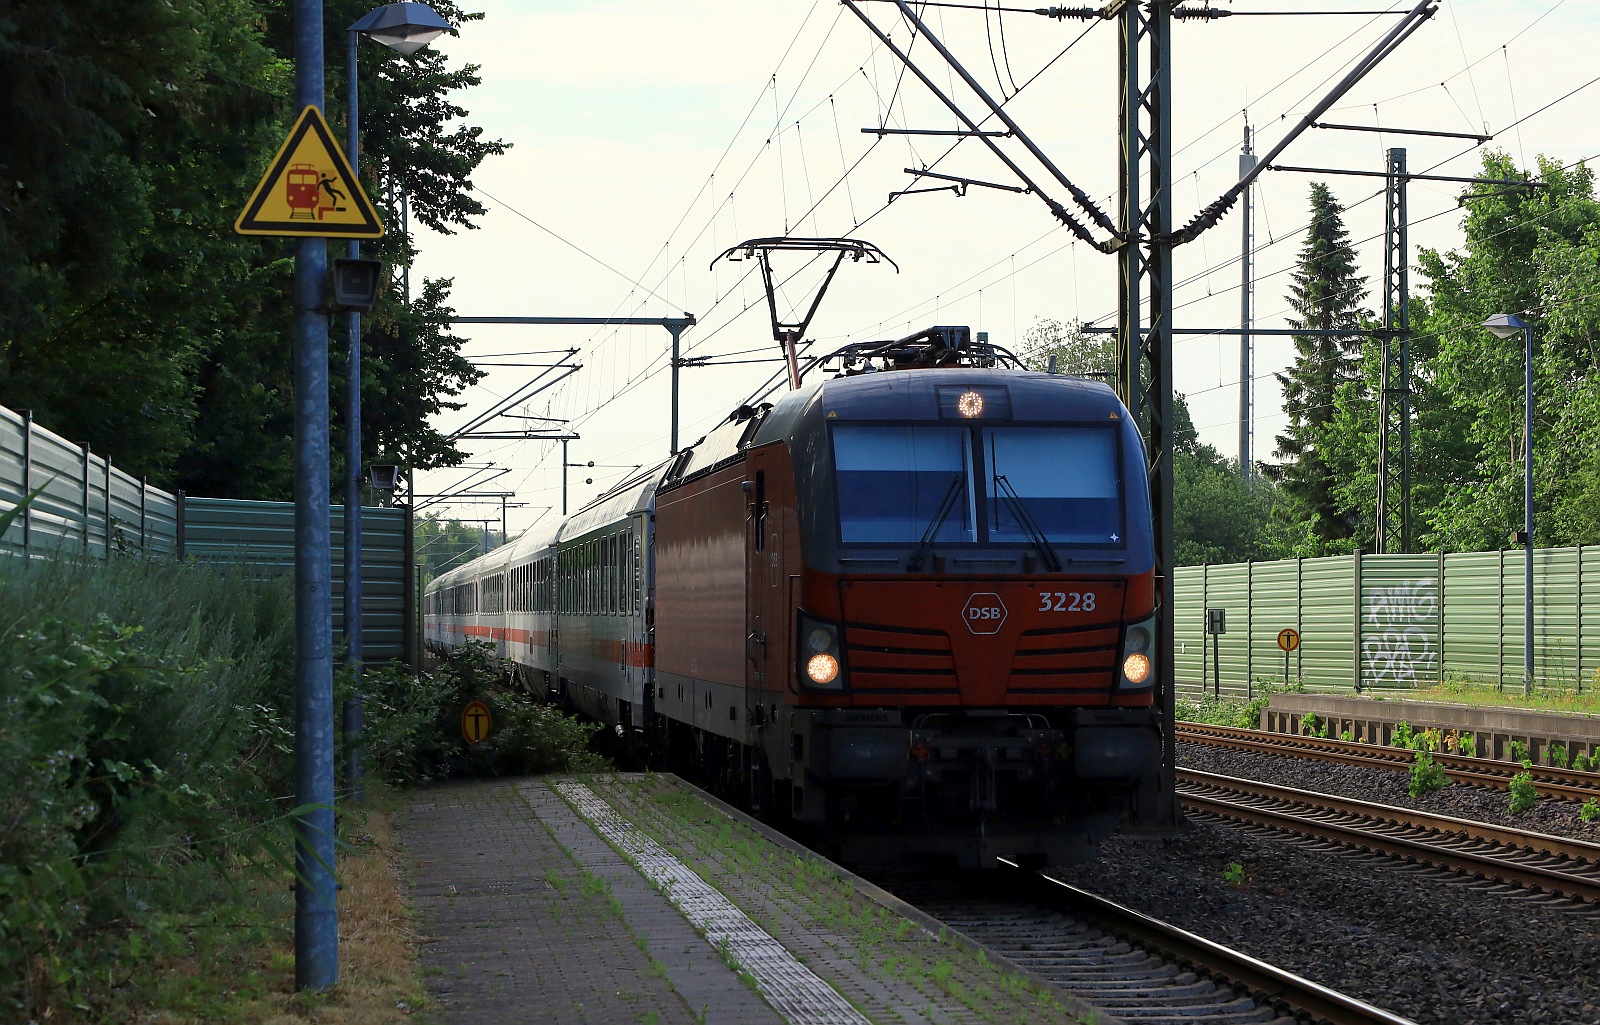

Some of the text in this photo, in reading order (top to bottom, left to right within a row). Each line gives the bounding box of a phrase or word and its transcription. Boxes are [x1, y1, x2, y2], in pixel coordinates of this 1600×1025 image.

[1038, 592, 1096, 612] 3228
[969, 607, 1001, 620] DSB
[846, 714, 888, 722] SIEMENS
